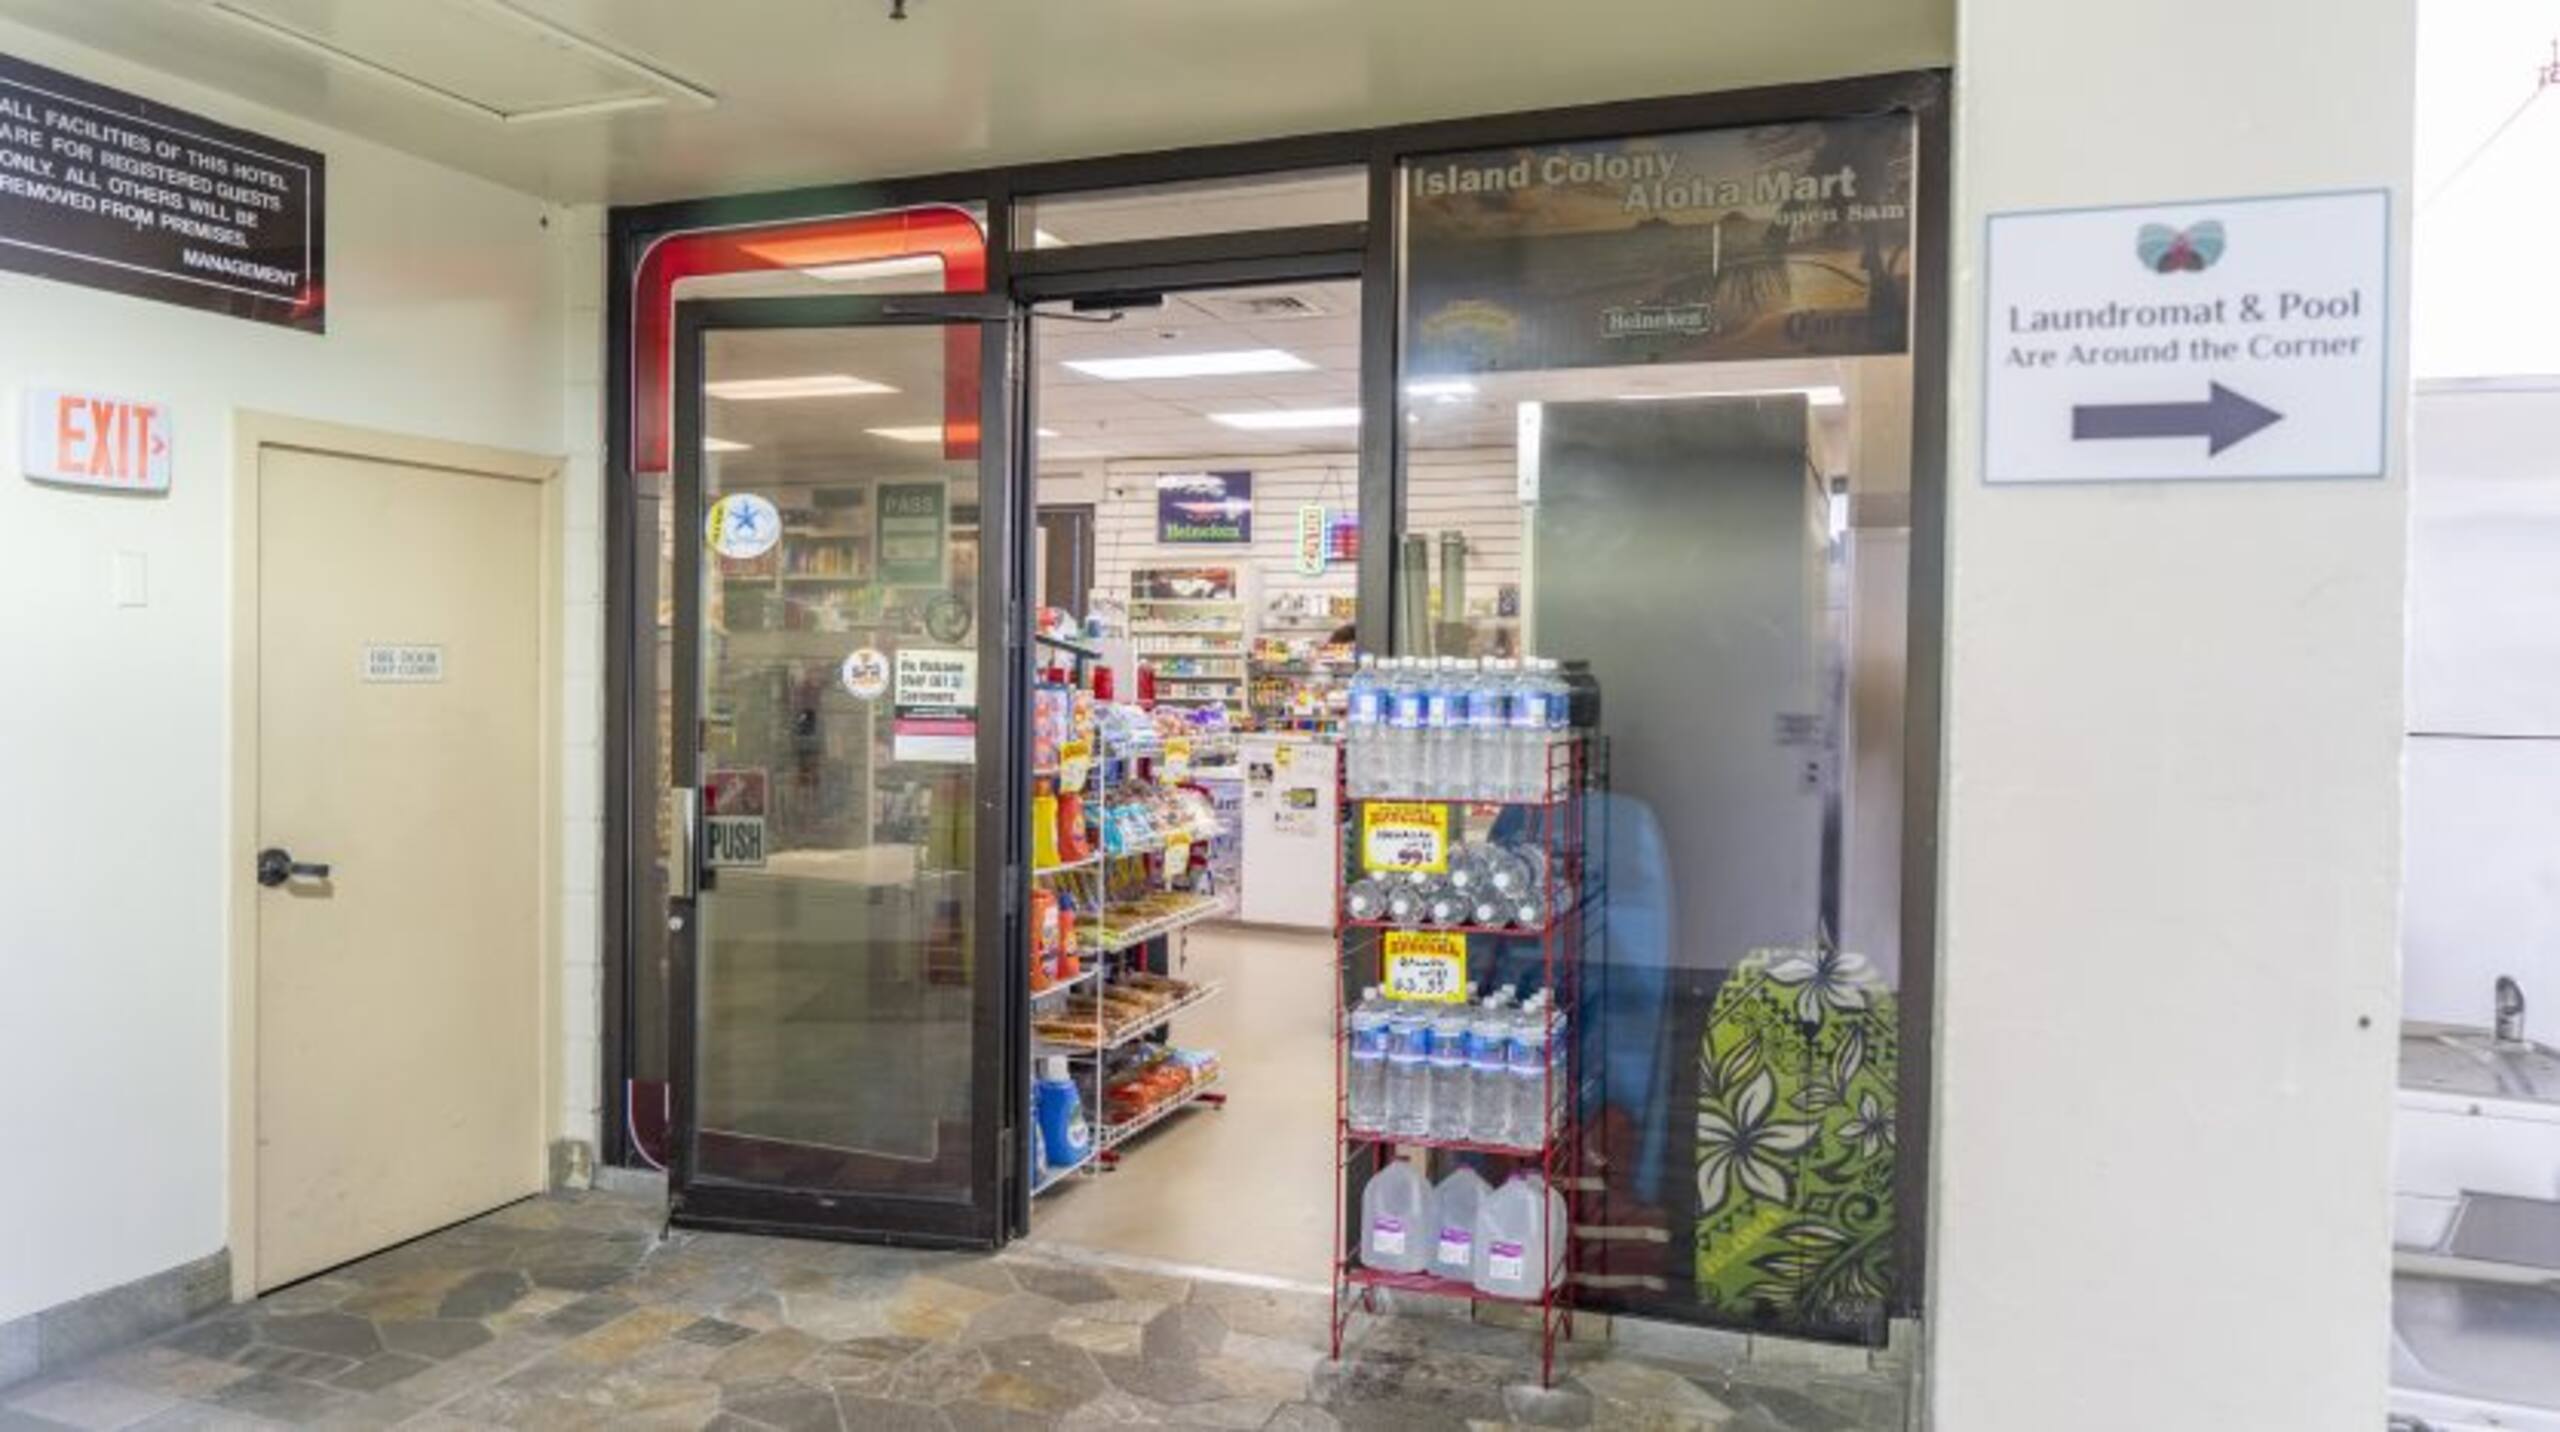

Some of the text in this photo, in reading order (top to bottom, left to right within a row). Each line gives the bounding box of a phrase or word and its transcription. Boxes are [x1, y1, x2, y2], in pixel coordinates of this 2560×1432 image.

[0, 96, 289, 192] ALL FACILITIES OF THIS HOTEL
[0, 120, 282, 211] ARE FOR REGISTERED GUESTS
[0, 149, 258, 228] ONLY. ALL OTHERS WILL BE
[1414, 149, 1679, 197] Island Colony
[1623, 164, 1857, 213] Aloha Mart
[0, 175, 249, 249] REMOVED FROM PREMISES.
[1775, 208, 1838, 229] open
[182, 248, 298, 286] MANAGEMENT
[1608, 311, 1702, 332] Heineken
[2009, 288, 2361, 334] Laundromat & Pool
[2005, 334, 2362, 369] Are Around the Corner
[57, 394, 157, 481] EXIT
[707, 820, 762, 861] PUSH
